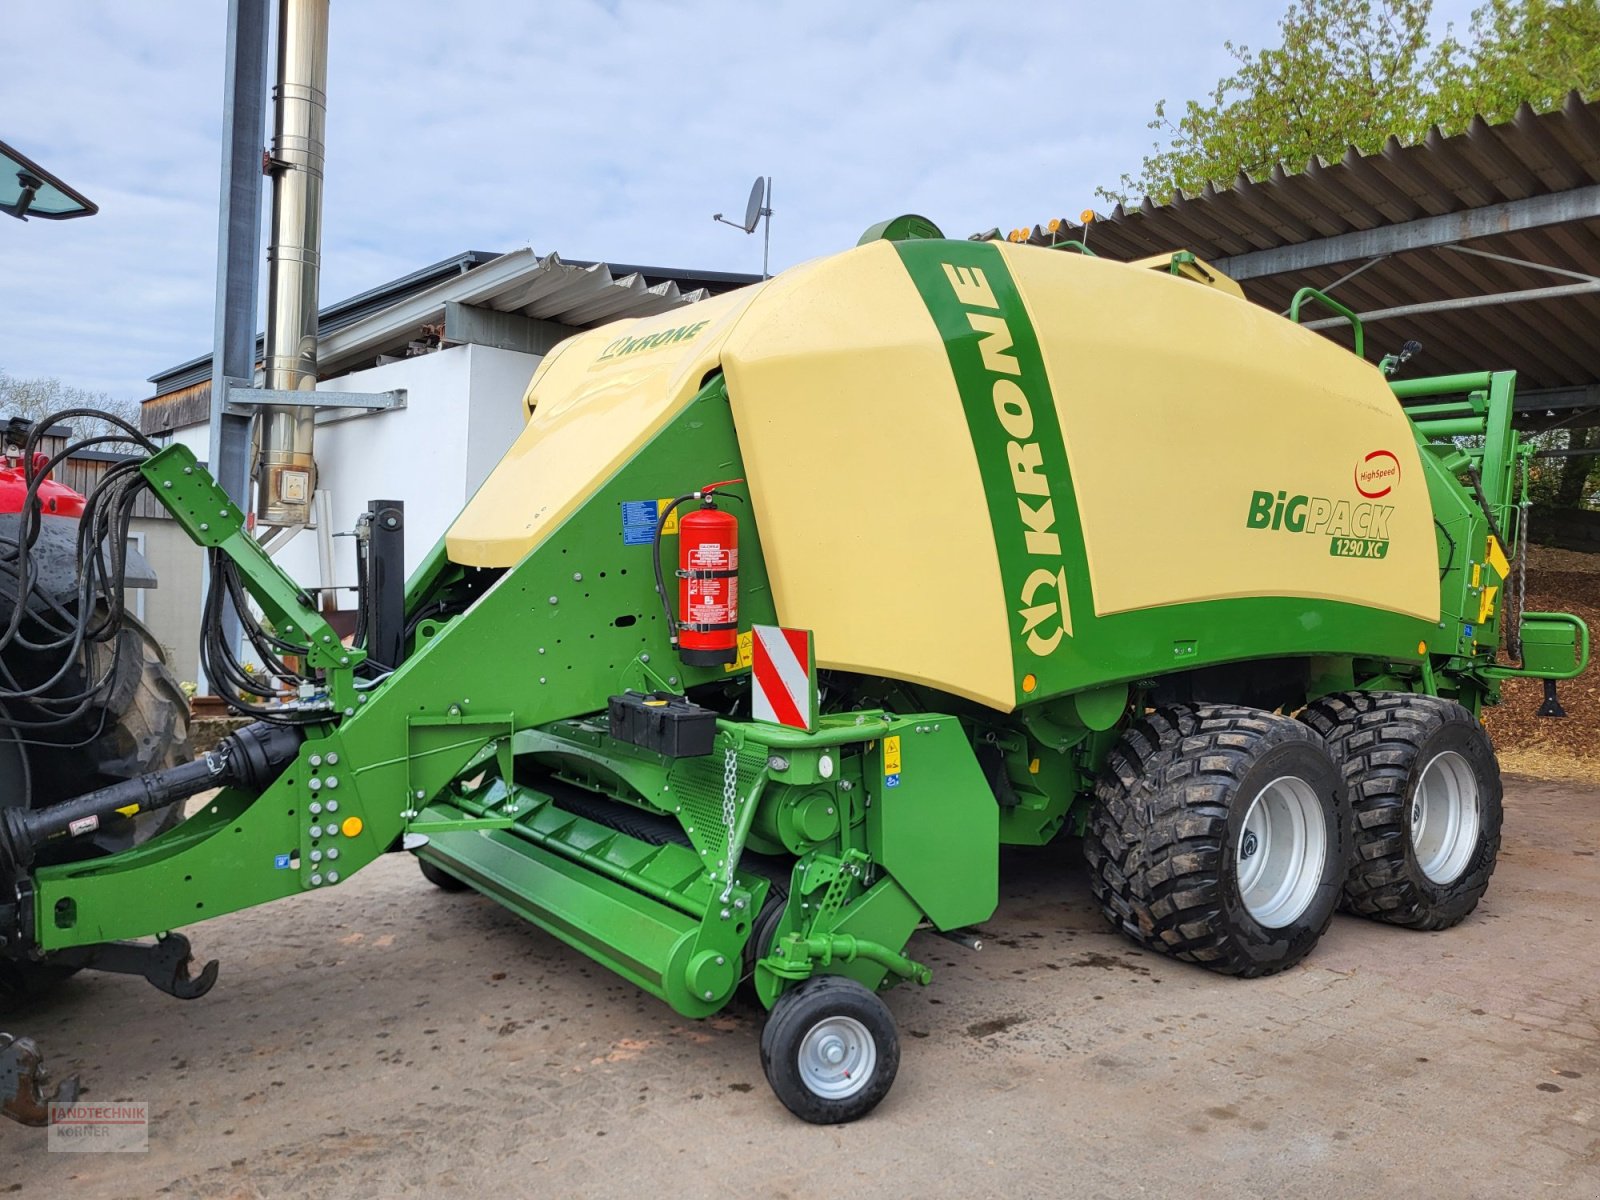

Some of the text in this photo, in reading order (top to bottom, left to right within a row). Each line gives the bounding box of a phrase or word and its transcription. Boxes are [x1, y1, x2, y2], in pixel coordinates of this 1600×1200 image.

[617, 319, 711, 356] KRONE
[941, 262, 1062, 556] KRONE
[1360, 466, 1396, 483] HighSpeed
[1336, 539, 1383, 558] 1290 XC
